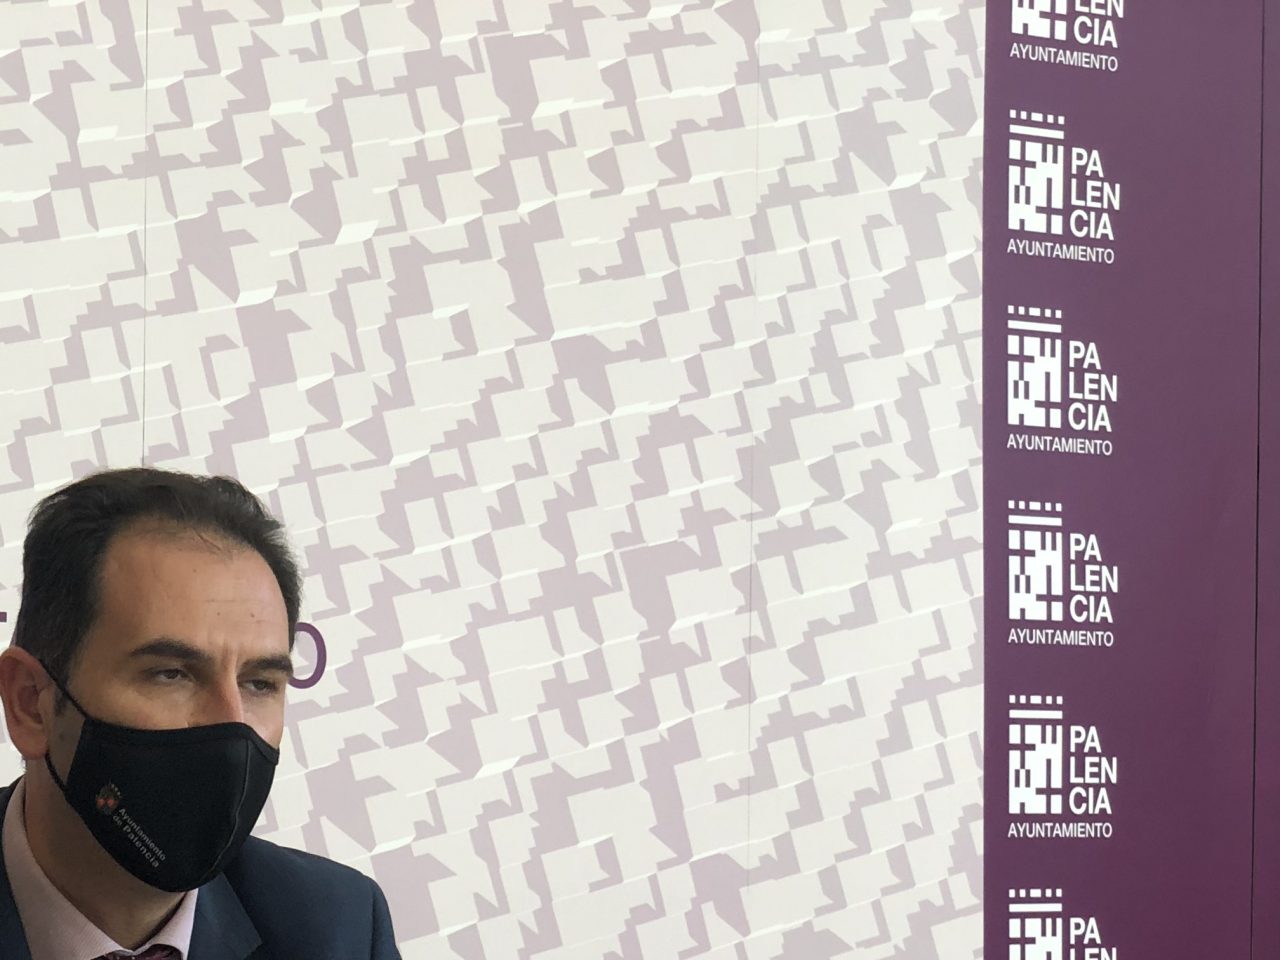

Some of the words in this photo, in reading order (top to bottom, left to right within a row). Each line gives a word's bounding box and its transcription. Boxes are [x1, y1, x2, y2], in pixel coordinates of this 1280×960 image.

[1074, 15, 1118, 48] CIA
[1009, 42, 1119, 72] AYUNTAMIENTO
[1071, 147, 1105, 177] PA
[1071, 178, 1120, 210] LEN
[1070, 209, 1115, 240] CIA
[1007, 238, 1115, 264] AYUNTAMIENTO
[1069, 340, 1102, 370] PA
[1069, 371, 1118, 402] LEN
[1068, 402, 1113, 432] CIA
[1007, 433, 1113, 456] AYUNTAMIENTO
[1070, 533, 1102, 561] PA
[1070, 564, 1118, 593] LEN
[1070, 594, 1114, 623] CIA
[1007, 627, 1114, 647] AYUNTAMIENTO
[1070, 726, 1102, 753] PA
[1070, 756, 1118, 784] LEN
[1069, 786, 1113, 814] CIA
[119, 808, 166, 861] Ayuntamiento
[1007, 822, 1113, 839] AYUNTAMIENTO
[123, 825, 160, 868] Palencia
[1070, 917, 1102, 945] PA
